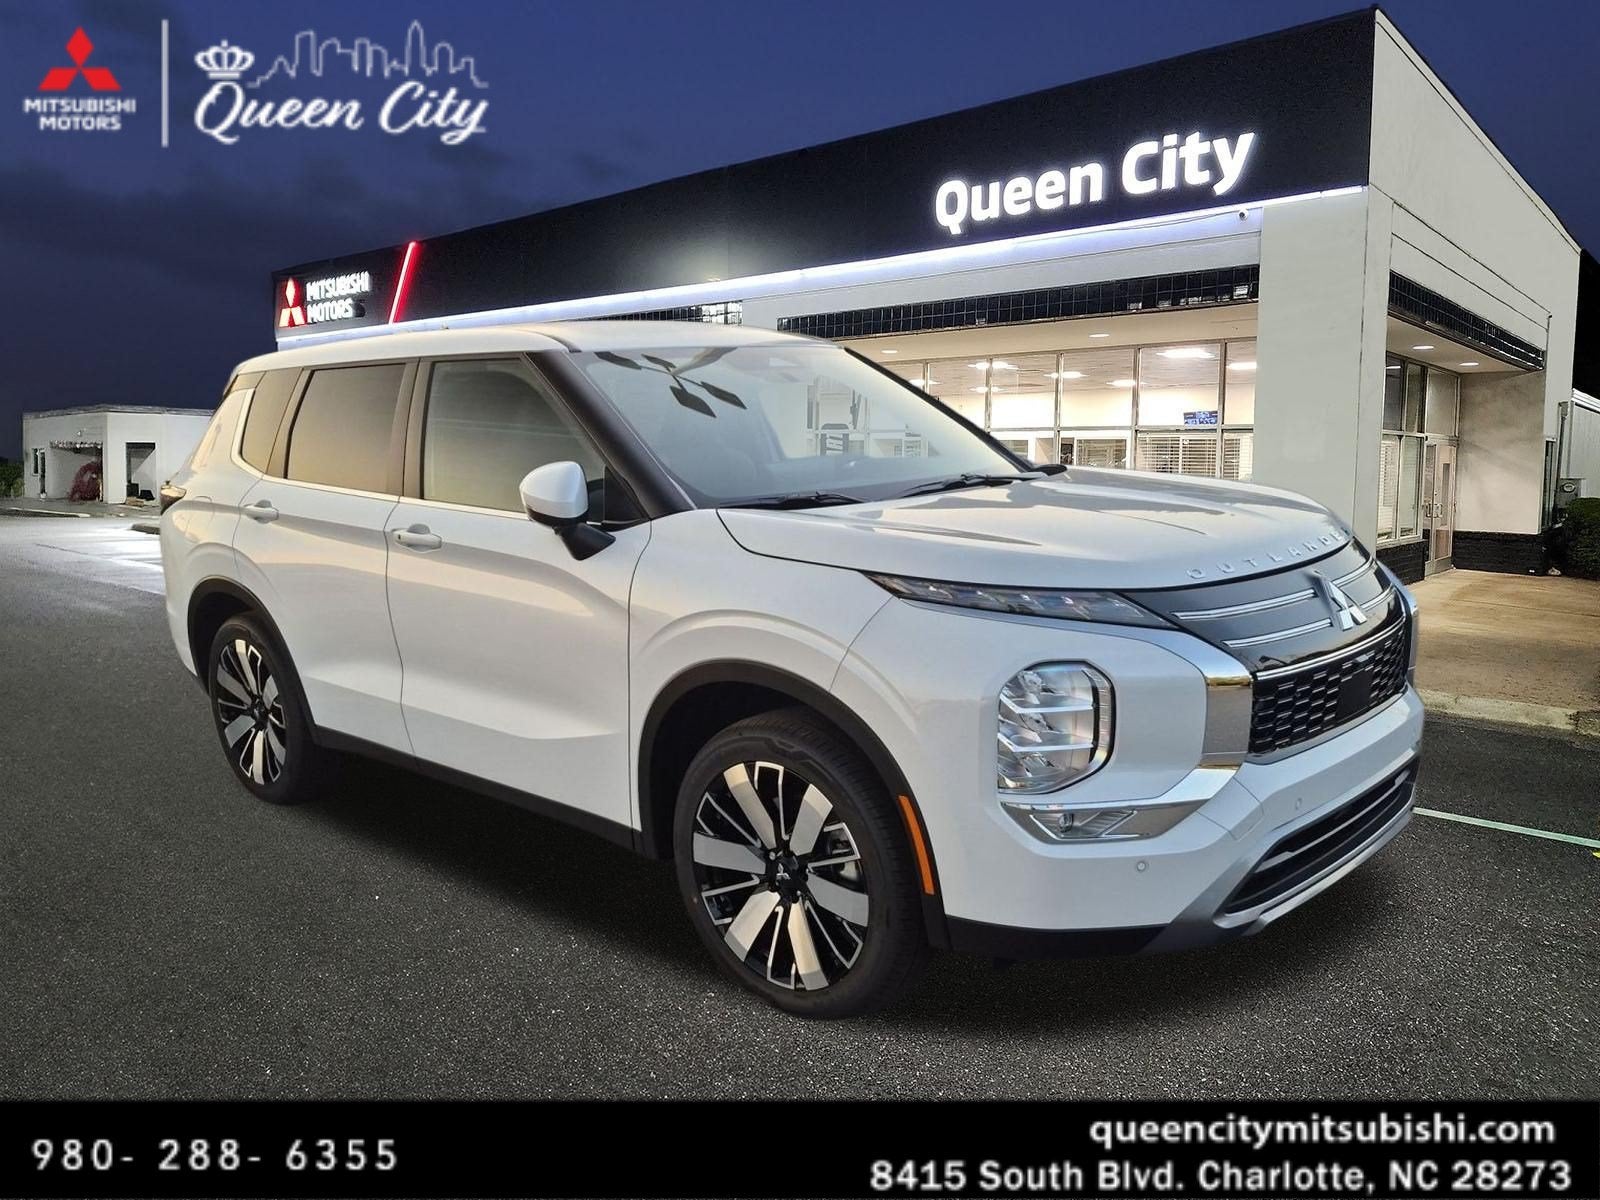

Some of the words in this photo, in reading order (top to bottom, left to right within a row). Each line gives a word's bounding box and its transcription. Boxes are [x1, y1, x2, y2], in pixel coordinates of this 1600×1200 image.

[935, 162, 1104, 236] Queen
[1121, 131, 1256, 196] City
[305, 271, 370, 301] MITSUBISHI
[306, 298, 355, 324] MOTORS
